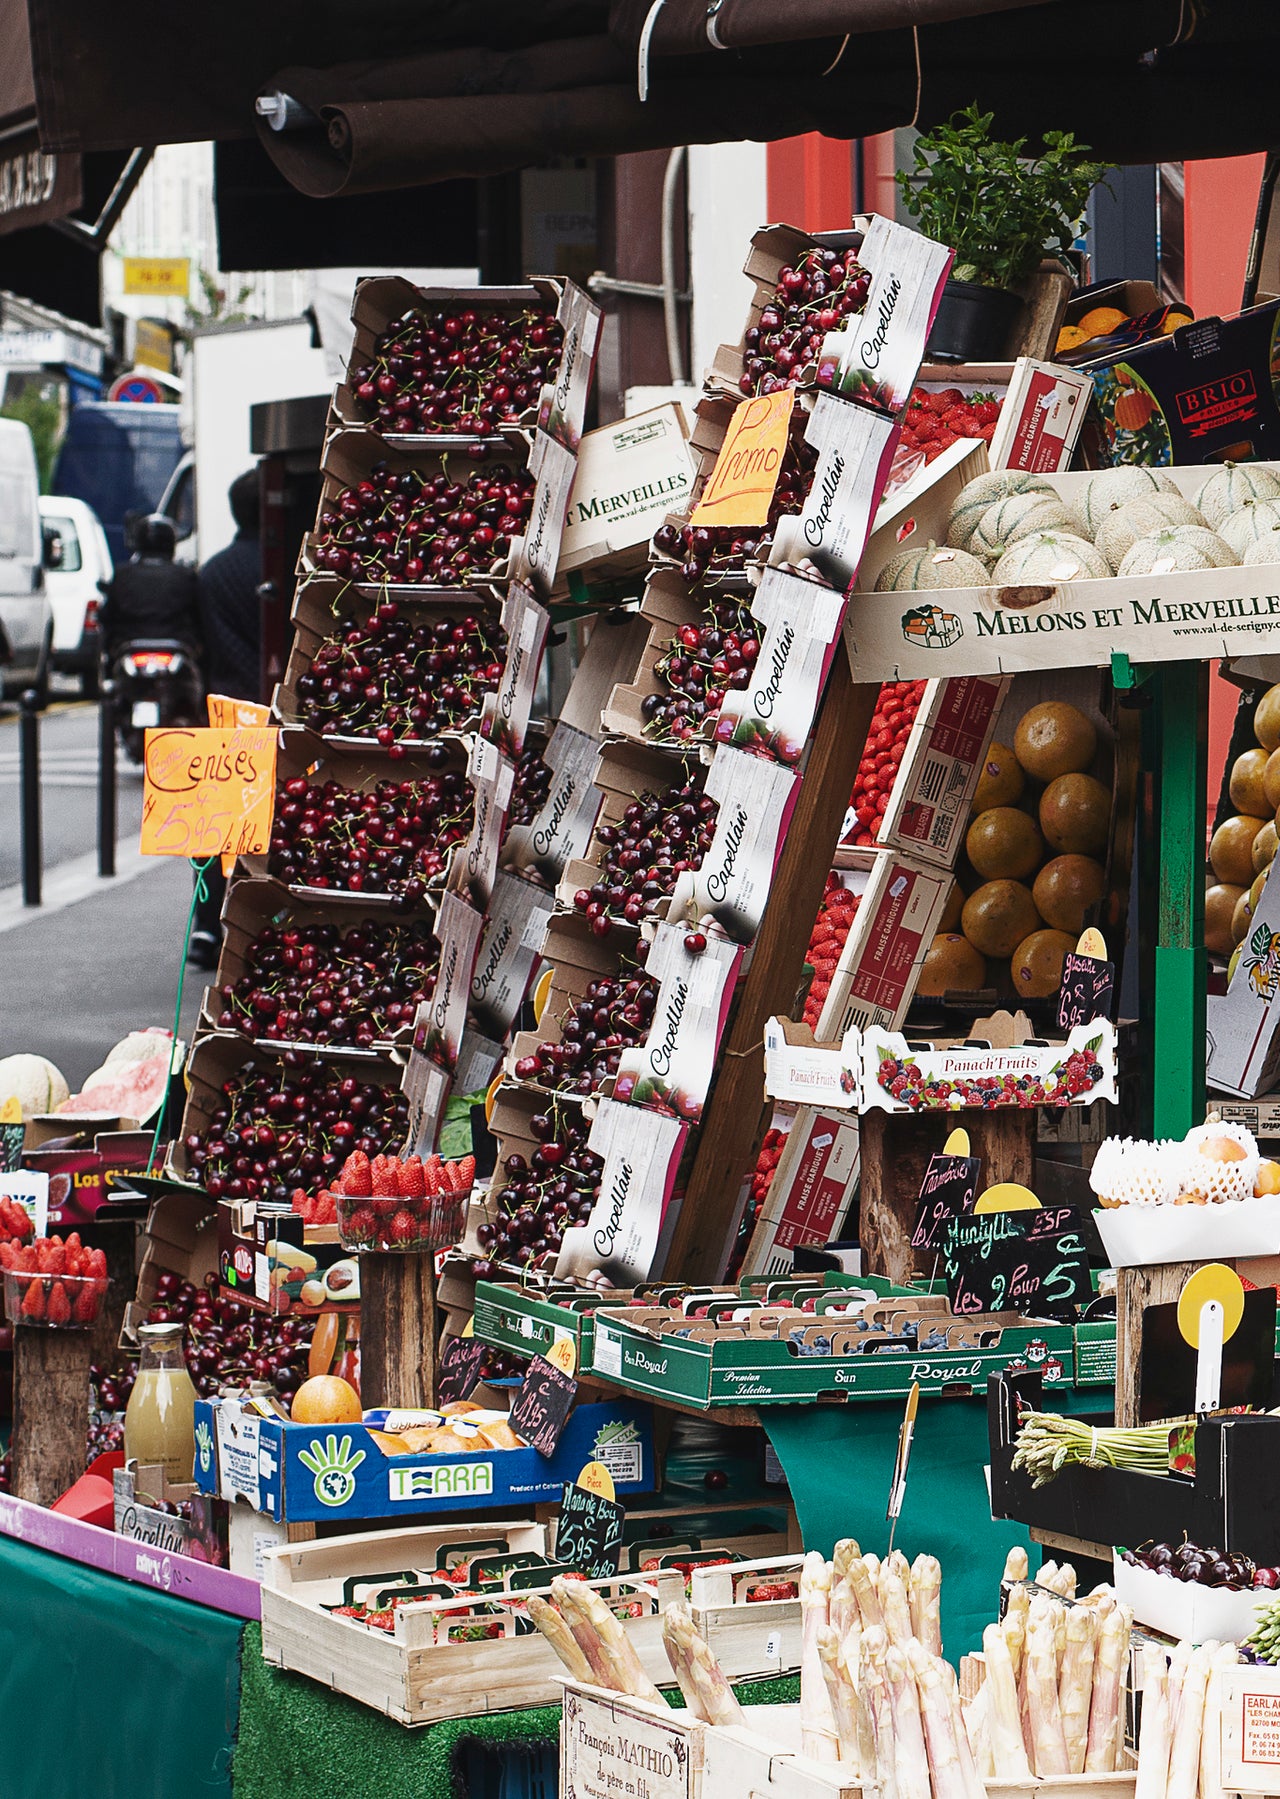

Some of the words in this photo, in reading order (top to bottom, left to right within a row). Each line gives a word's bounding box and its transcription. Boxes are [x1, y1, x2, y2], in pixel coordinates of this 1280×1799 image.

[861, 276, 901, 370] Capellán
[1185, 377, 1246, 411] BRIO
[577, 472, 688, 525] MERVEILLES
[805, 455, 845, 547] Capellán
[527, 487, 553, 568] Capellán
[973, 608, 1087, 638] MELONS
[1094, 608, 1124, 628] ET
[754, 625, 795, 719] Capellán
[533, 776, 576, 857] Capellán
[913, 805, 932, 838] SOLARENN
[707, 806, 749, 902] Capellán
[472, 924, 514, 1002] Capellán
[874, 935, 890, 962] FRAISE
[435, 945, 458, 1029] Capellán
[650, 980, 690, 1077] Capellán
[789, 1068, 837, 1087] Panach'Fruits
[944, 1056, 1039, 1073] Panach'Fruits
[74, 1172, 99, 1188] Los
[594, 1161, 635, 1258] Capellán
[797, 1185, 812, 1211] FRAISE
[1031, 1208, 1072, 1235] ESP
[953, 1275, 983, 1315] Les
[990, 1274, 1006, 1312] 2
[1042, 1261, 1081, 1301] 5
[557, 1344, 571, 1367] 1kg
[635, 1352, 669, 1375] Royal
[834, 1368, 857, 1384] Sun
[908, 1360, 982, 1384] Royal
[509, 1484, 534, 1493] Produce
[587, 1476, 602, 1489] Pièce
[1247, 1697, 1269, 1709] EARL
[1251, 1719, 1270, 1728] 82700
[578, 1720, 615, 1758] François
[617, 1736, 673, 1778] MATHIO
[597, 1760, 606, 1782] de
[607, 1771, 624, 1791] père
[625, 1781, 635, 1796] en
[637, 1777, 651, 1799] fils
